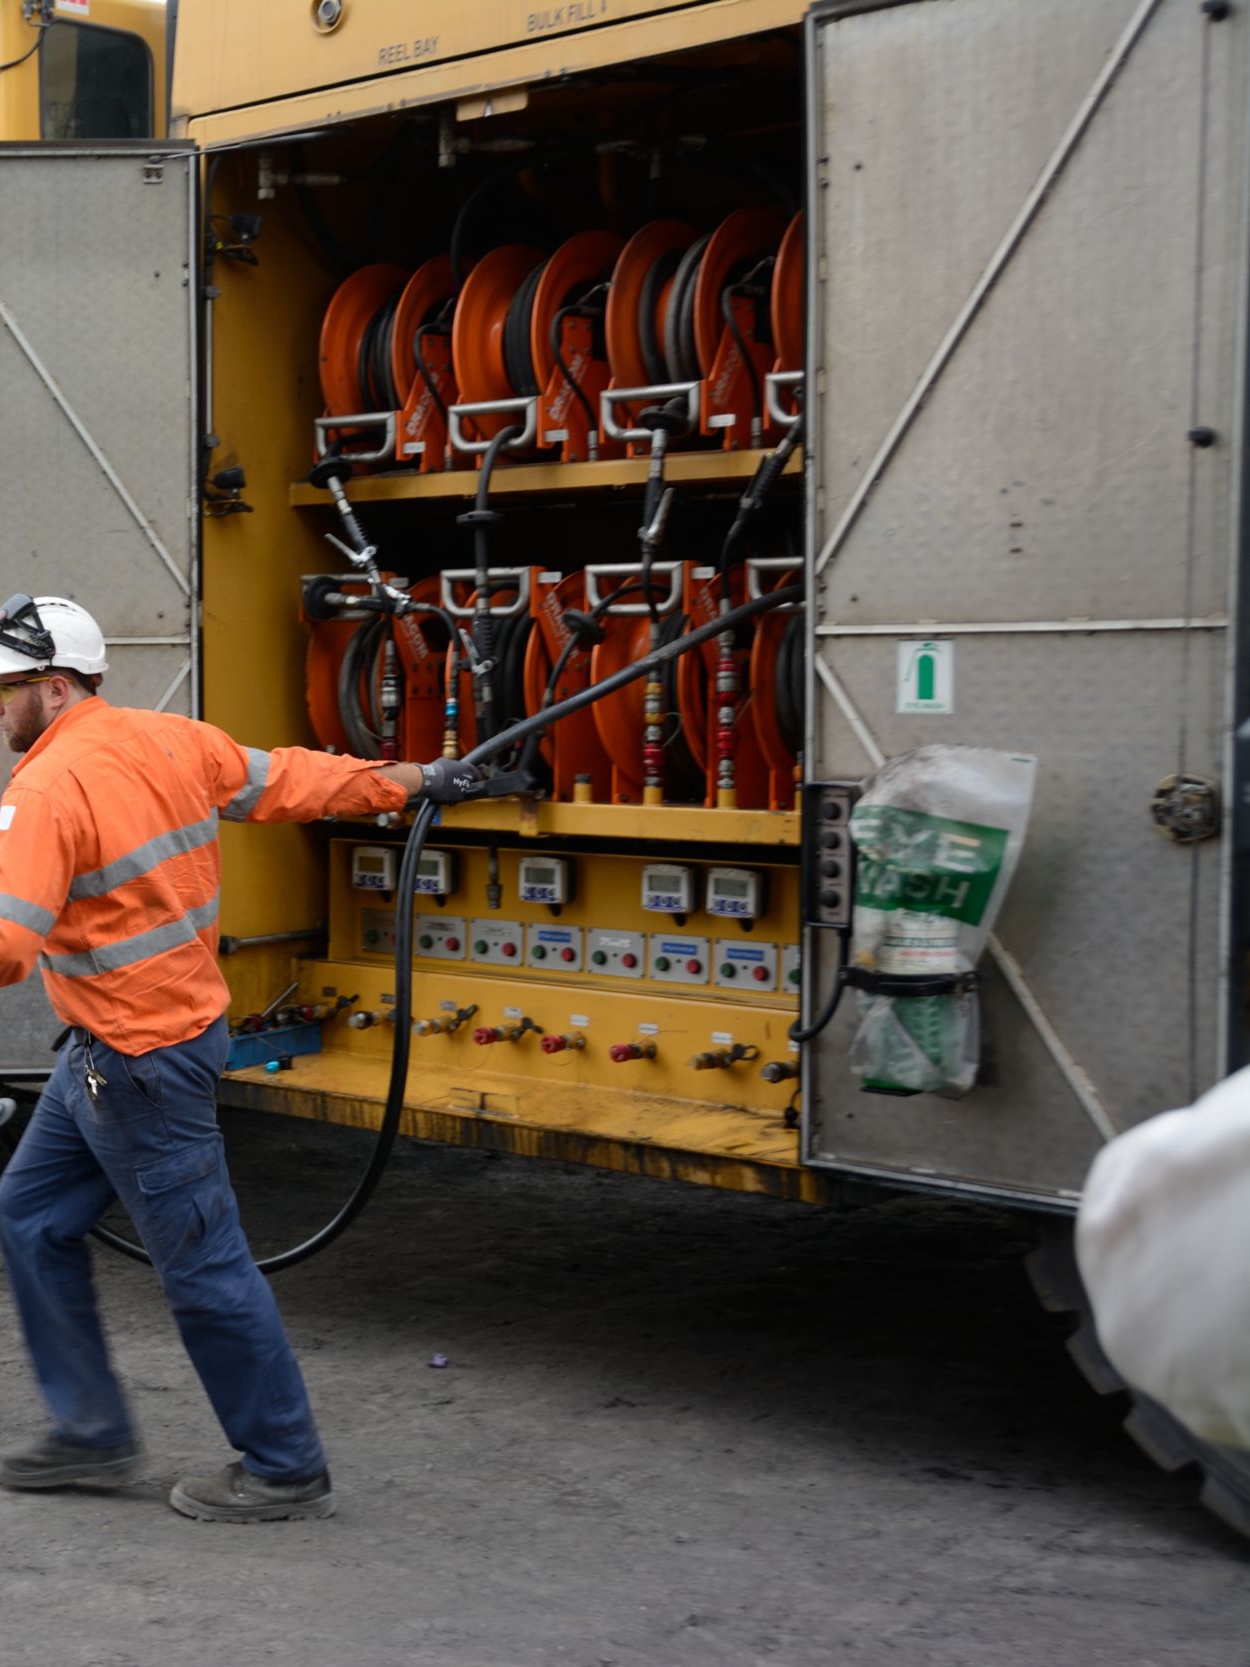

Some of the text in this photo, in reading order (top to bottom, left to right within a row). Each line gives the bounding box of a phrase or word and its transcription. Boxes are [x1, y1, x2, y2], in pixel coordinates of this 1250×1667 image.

[526, 1, 596, 32] BULK FILL
[378, 36, 440, 66] REEL BAY
[850, 817, 981, 873] EYE
[858, 858, 971, 908] WASH
